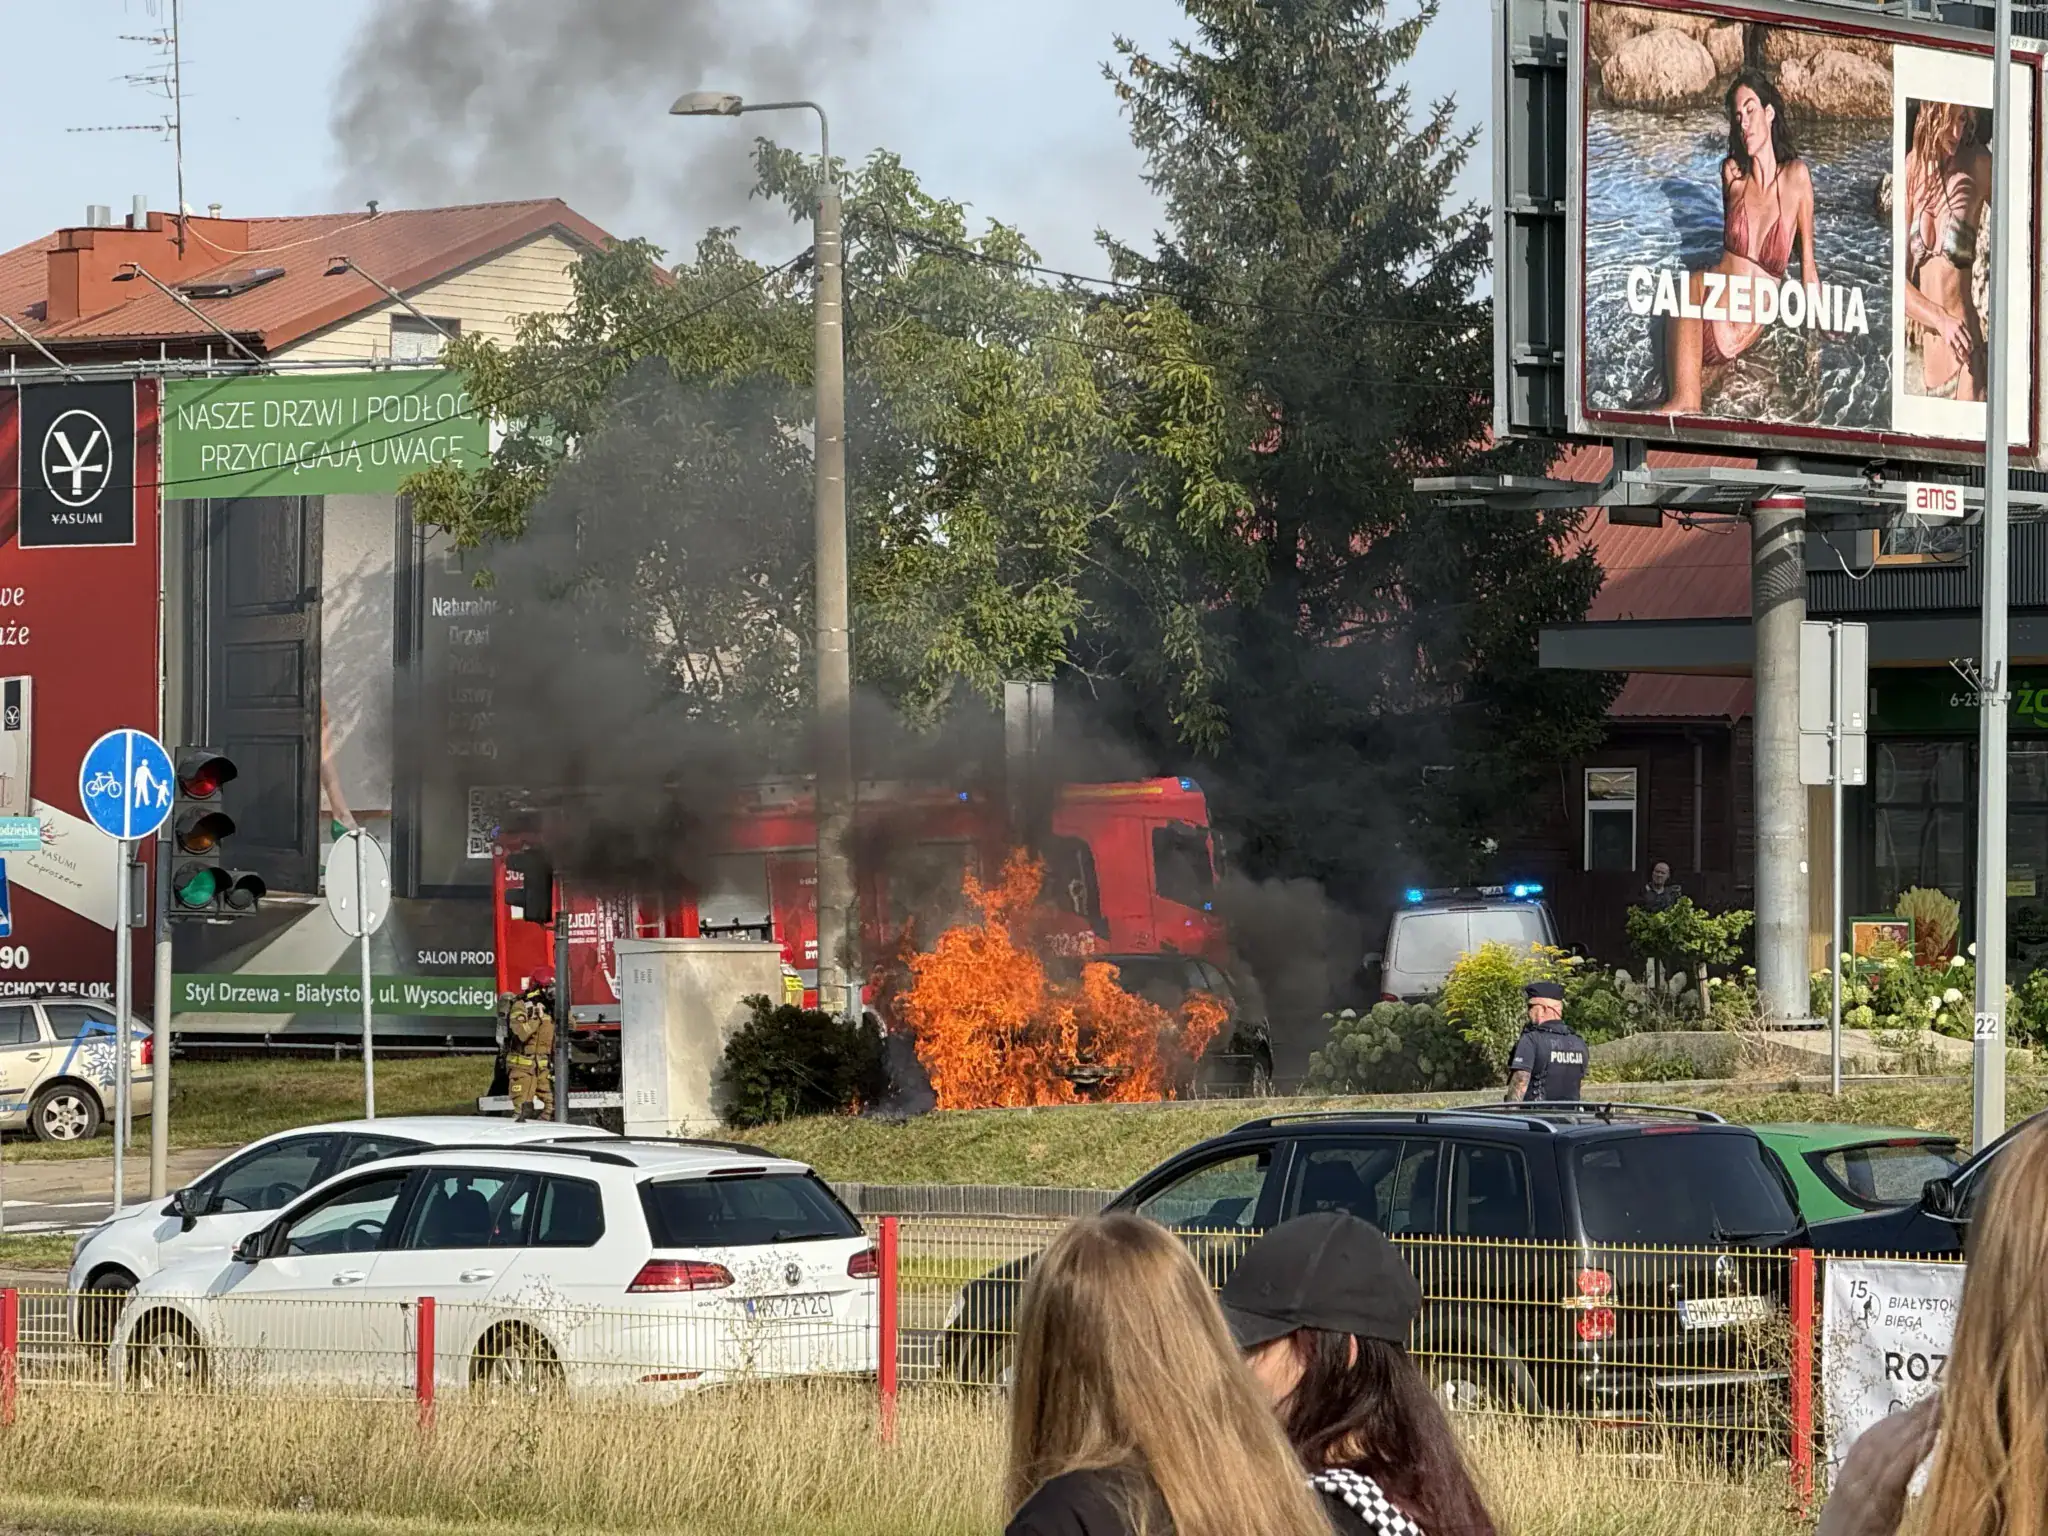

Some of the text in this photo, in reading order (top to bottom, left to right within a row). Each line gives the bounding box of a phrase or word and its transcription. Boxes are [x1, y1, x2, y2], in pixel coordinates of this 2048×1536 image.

[1627, 266, 1870, 334] CALZEDONIA
[178, 393, 480, 431] NASZE DRZWI I PODŁOG
[201, 435, 465, 475] PRZYCIĄGAJĄ UWAGĘ
[1916, 487, 1957, 511] ams
[0, 945, 30, 970] 90
[417, 950, 496, 965] SALON PROD
[80, 982, 116, 998] LOK.
[185, 982, 216, 1006] Styl
[219, 982, 280, 1003] Drzewa
[295, 983, 375, 1007] Białysto,
[379, 984, 400, 1004] ul.
[404, 984, 498, 1011] Wysockieg
[1976, 1017, 1997, 1035] 22
[1550, 1051, 1583, 1065] POLICJA
[1849, 1280, 1869, 1299] 15
[783, 1295, 830, 1318] 7212C
[1884, 1314, 1923, 1328] BIEGA
